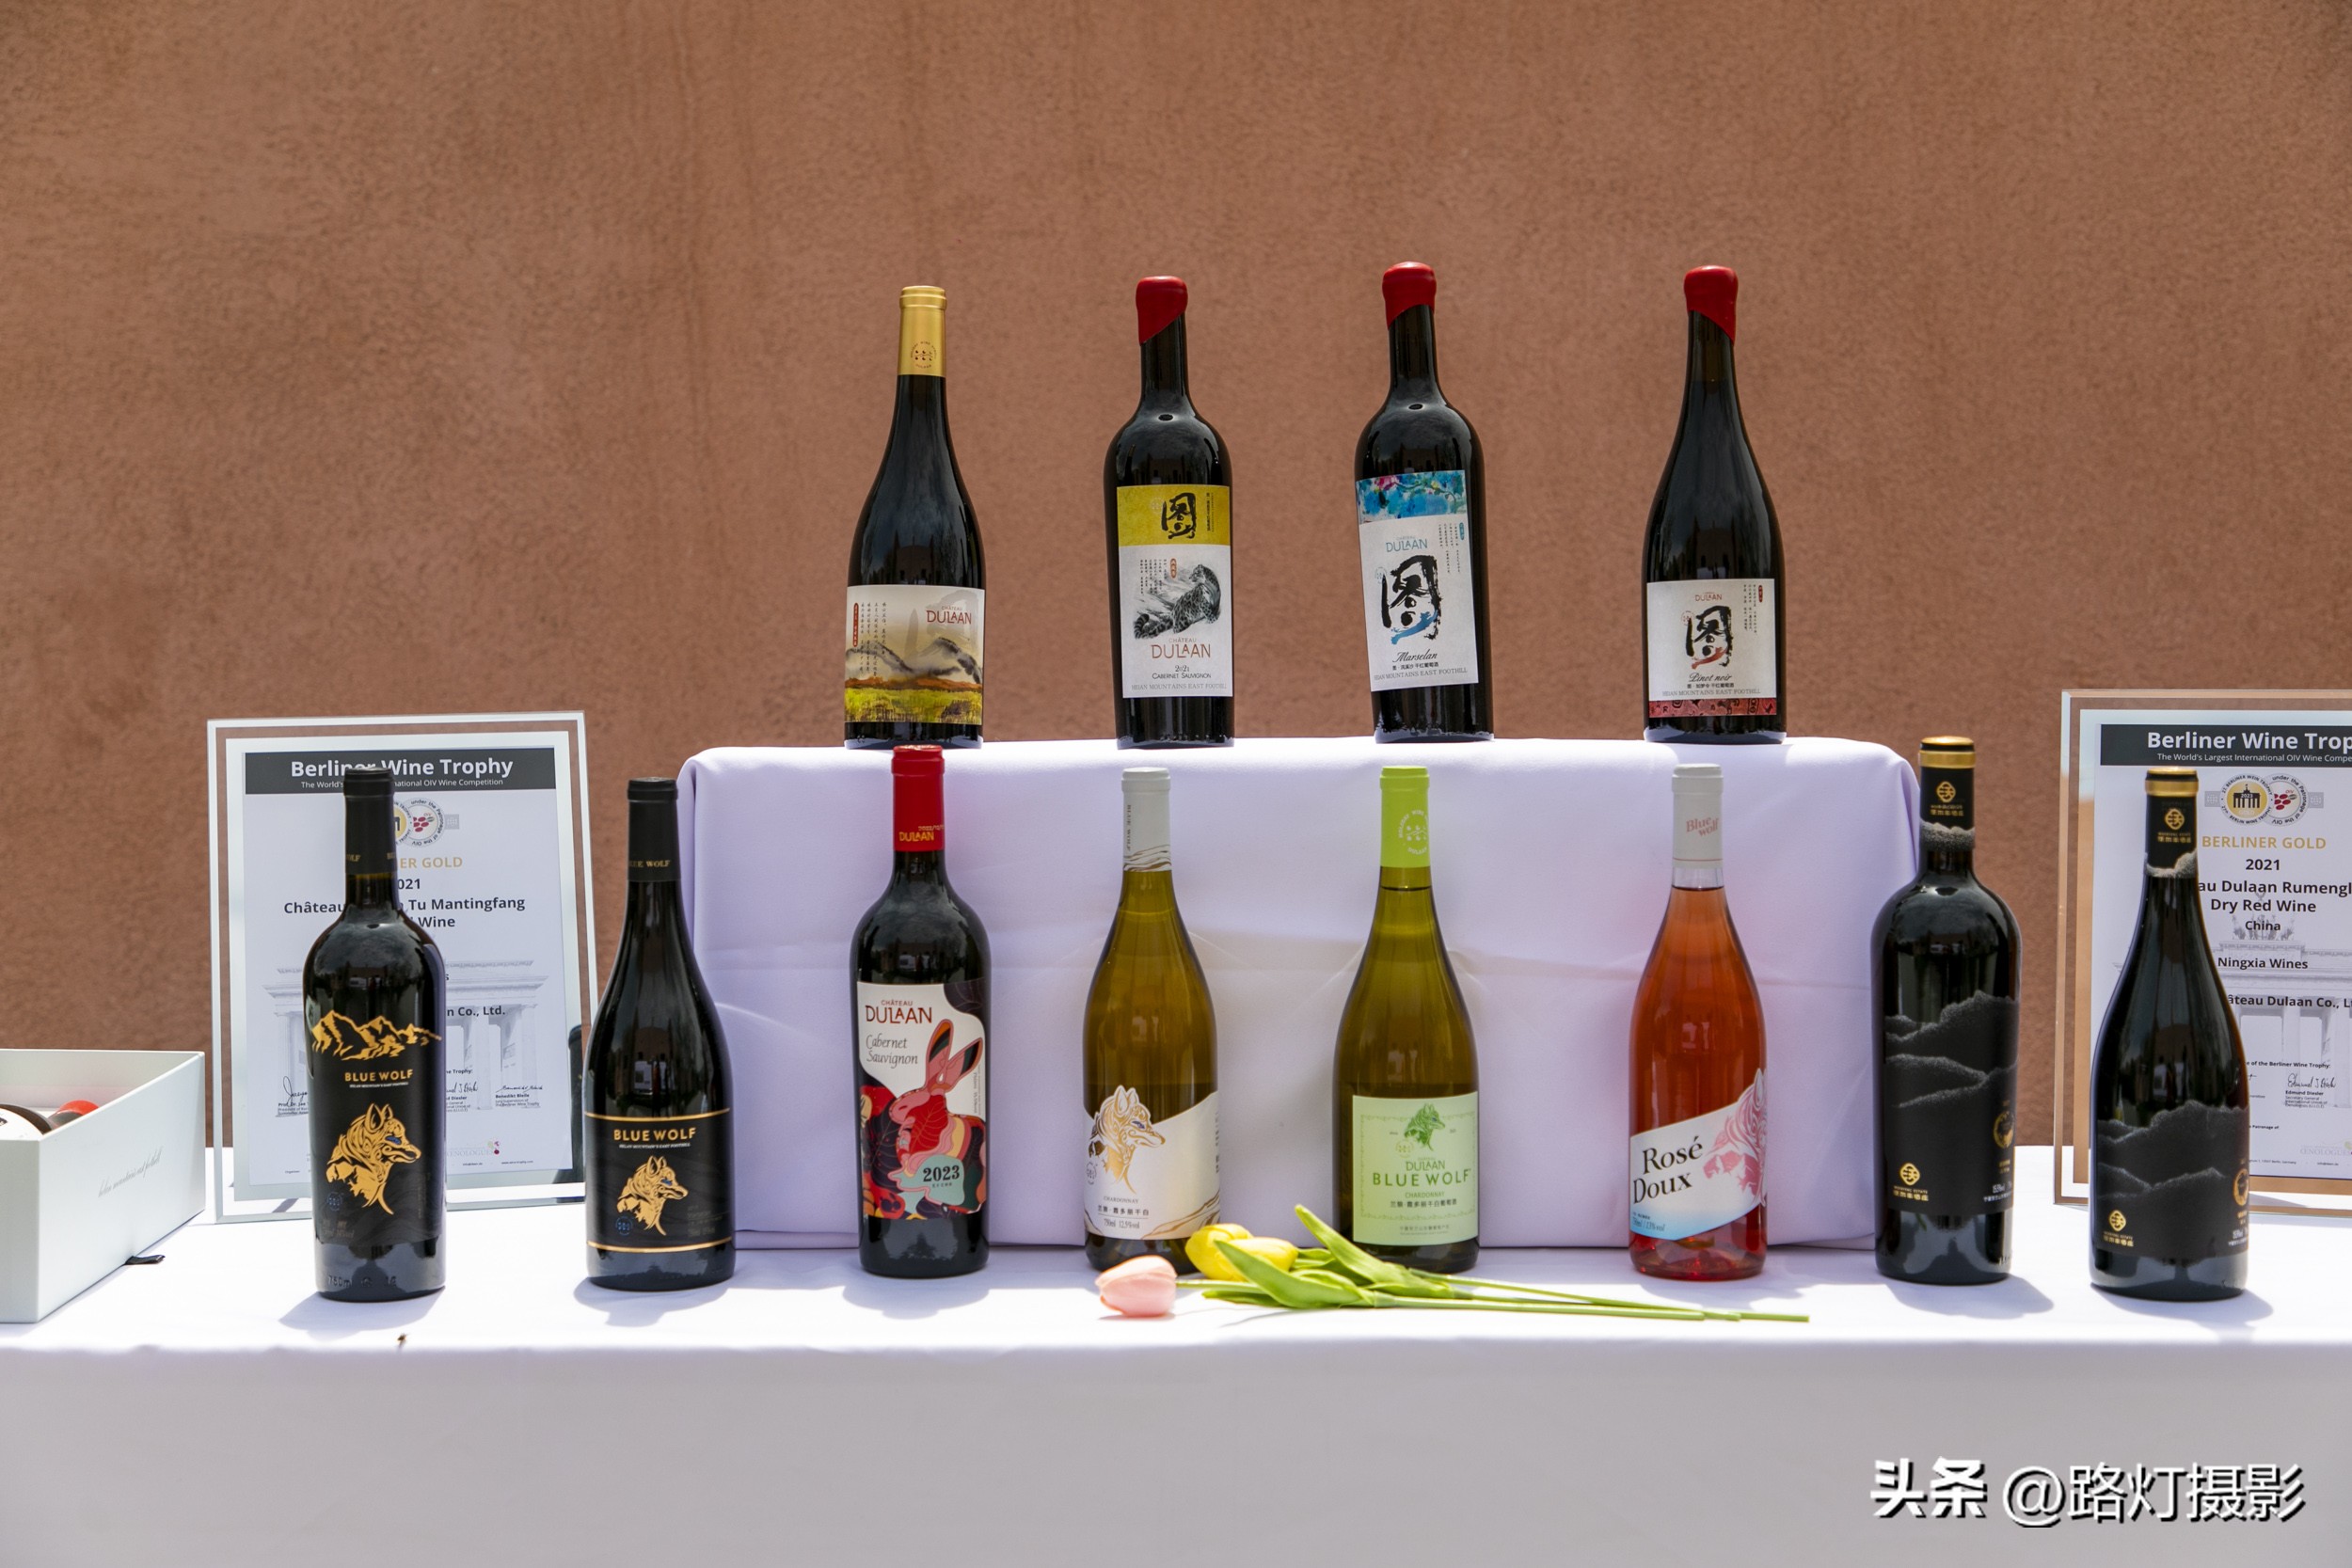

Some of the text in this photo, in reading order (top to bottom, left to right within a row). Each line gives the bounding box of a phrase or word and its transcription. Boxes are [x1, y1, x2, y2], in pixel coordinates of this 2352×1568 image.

[1386, 539, 1428, 553] DULAAN
[927, 610, 971, 625] DULAAN
[1151, 644, 1210, 659] DULAAN
[1392, 649, 1438, 663] Marselan
[1689, 673, 1714, 682] Pinot
[2148, 731, 2352, 754] Berliner Wine Trop
[2205, 754, 2232, 762] Largest
[381, 760, 434, 775] Wine
[439, 758, 513, 778] Trophy
[459, 778, 503, 787] Competition
[1686, 817, 1711, 832] Blue
[899, 832, 934, 841] DULAAN
[2202, 836, 2277, 848] BERLINER
[2282, 837, 2326, 849] GOLD
[422, 857, 462, 868] GOLD
[2246, 859, 2280, 870] 2021
[397, 879, 421, 889] 021
[2222, 880, 2277, 893] Dulaan
[2282, 882, 2352, 897] Rumengl
[284, 897, 525, 913] Château Tu Mantingfang
[2211, 899, 2316, 913] Dry Red Wine
[419, 917, 455, 927] Wine
[2245, 920, 2280, 931] China
[2218, 958, 2308, 970] Ningxia Wines
[2228, 995, 2339, 1008] âteau Dulaan Co.,
[458, 1006, 506, 1017] Co., Ltd.
[865, 1005, 932, 1024] DULAAN
[866, 1033, 907, 1049] Cabernet
[866, 1050, 918, 1069] Sauvignon
[345, 1069, 413, 1082] BLUE WOLF
[614, 1127, 696, 1141] BLUE WOLF
[1643, 1136, 1703, 1174] Rosé
[1406, 1160, 1445, 1171] DULAAN
[923, 1165, 960, 1182] 2023
[1373, 1169, 1470, 1187] BLUE WOLF
[1633, 1173, 1692, 1204] Doux
